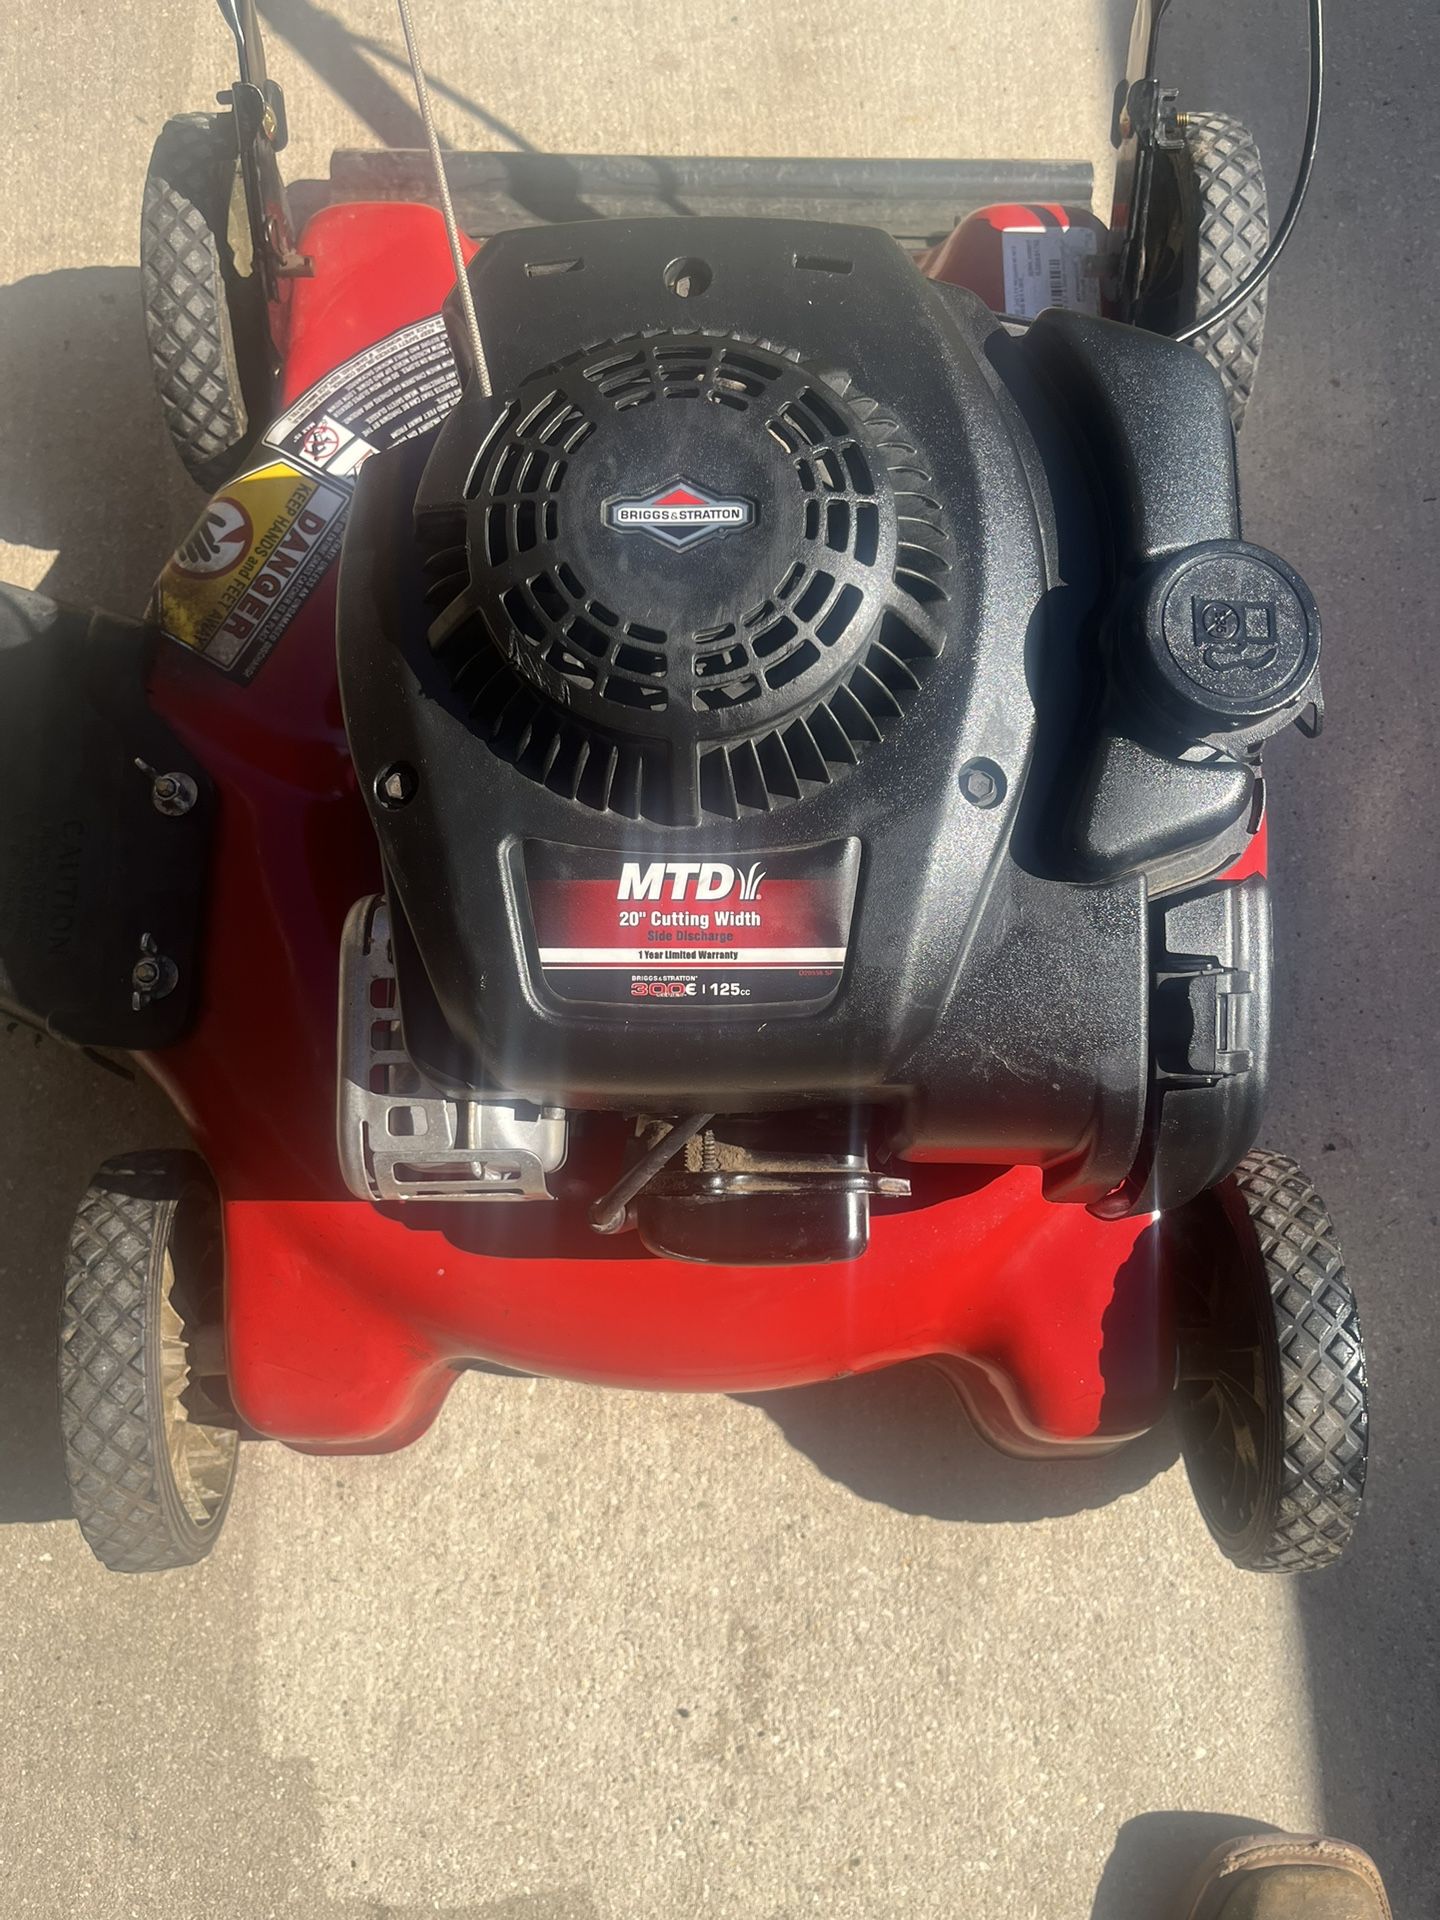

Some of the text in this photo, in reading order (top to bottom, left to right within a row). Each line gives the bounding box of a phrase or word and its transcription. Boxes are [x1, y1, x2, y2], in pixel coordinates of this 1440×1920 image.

[397, 334, 419, 348] SAFETY
[408, 396, 421, 407] CAN
[420, 389, 434, 401] THAT
[422, 407, 437, 419] FEET
[406, 415, 423, 428] AWAY
[389, 424, 408, 439] FROM
[191, 481, 312, 646] KEEP HANDS and FEET AWAY
[221, 506, 327, 643] DANGER
[305, 559, 328, 588] UNLESS
[281, 573, 307, 606] CATCHER
[617, 862, 735, 900] MTD
[619, 911, 761, 929] 20" Cutting Width
[647, 931, 733, 943] Side Discharge
[638, 950, 738, 961] 1 Year Limited Warranty
